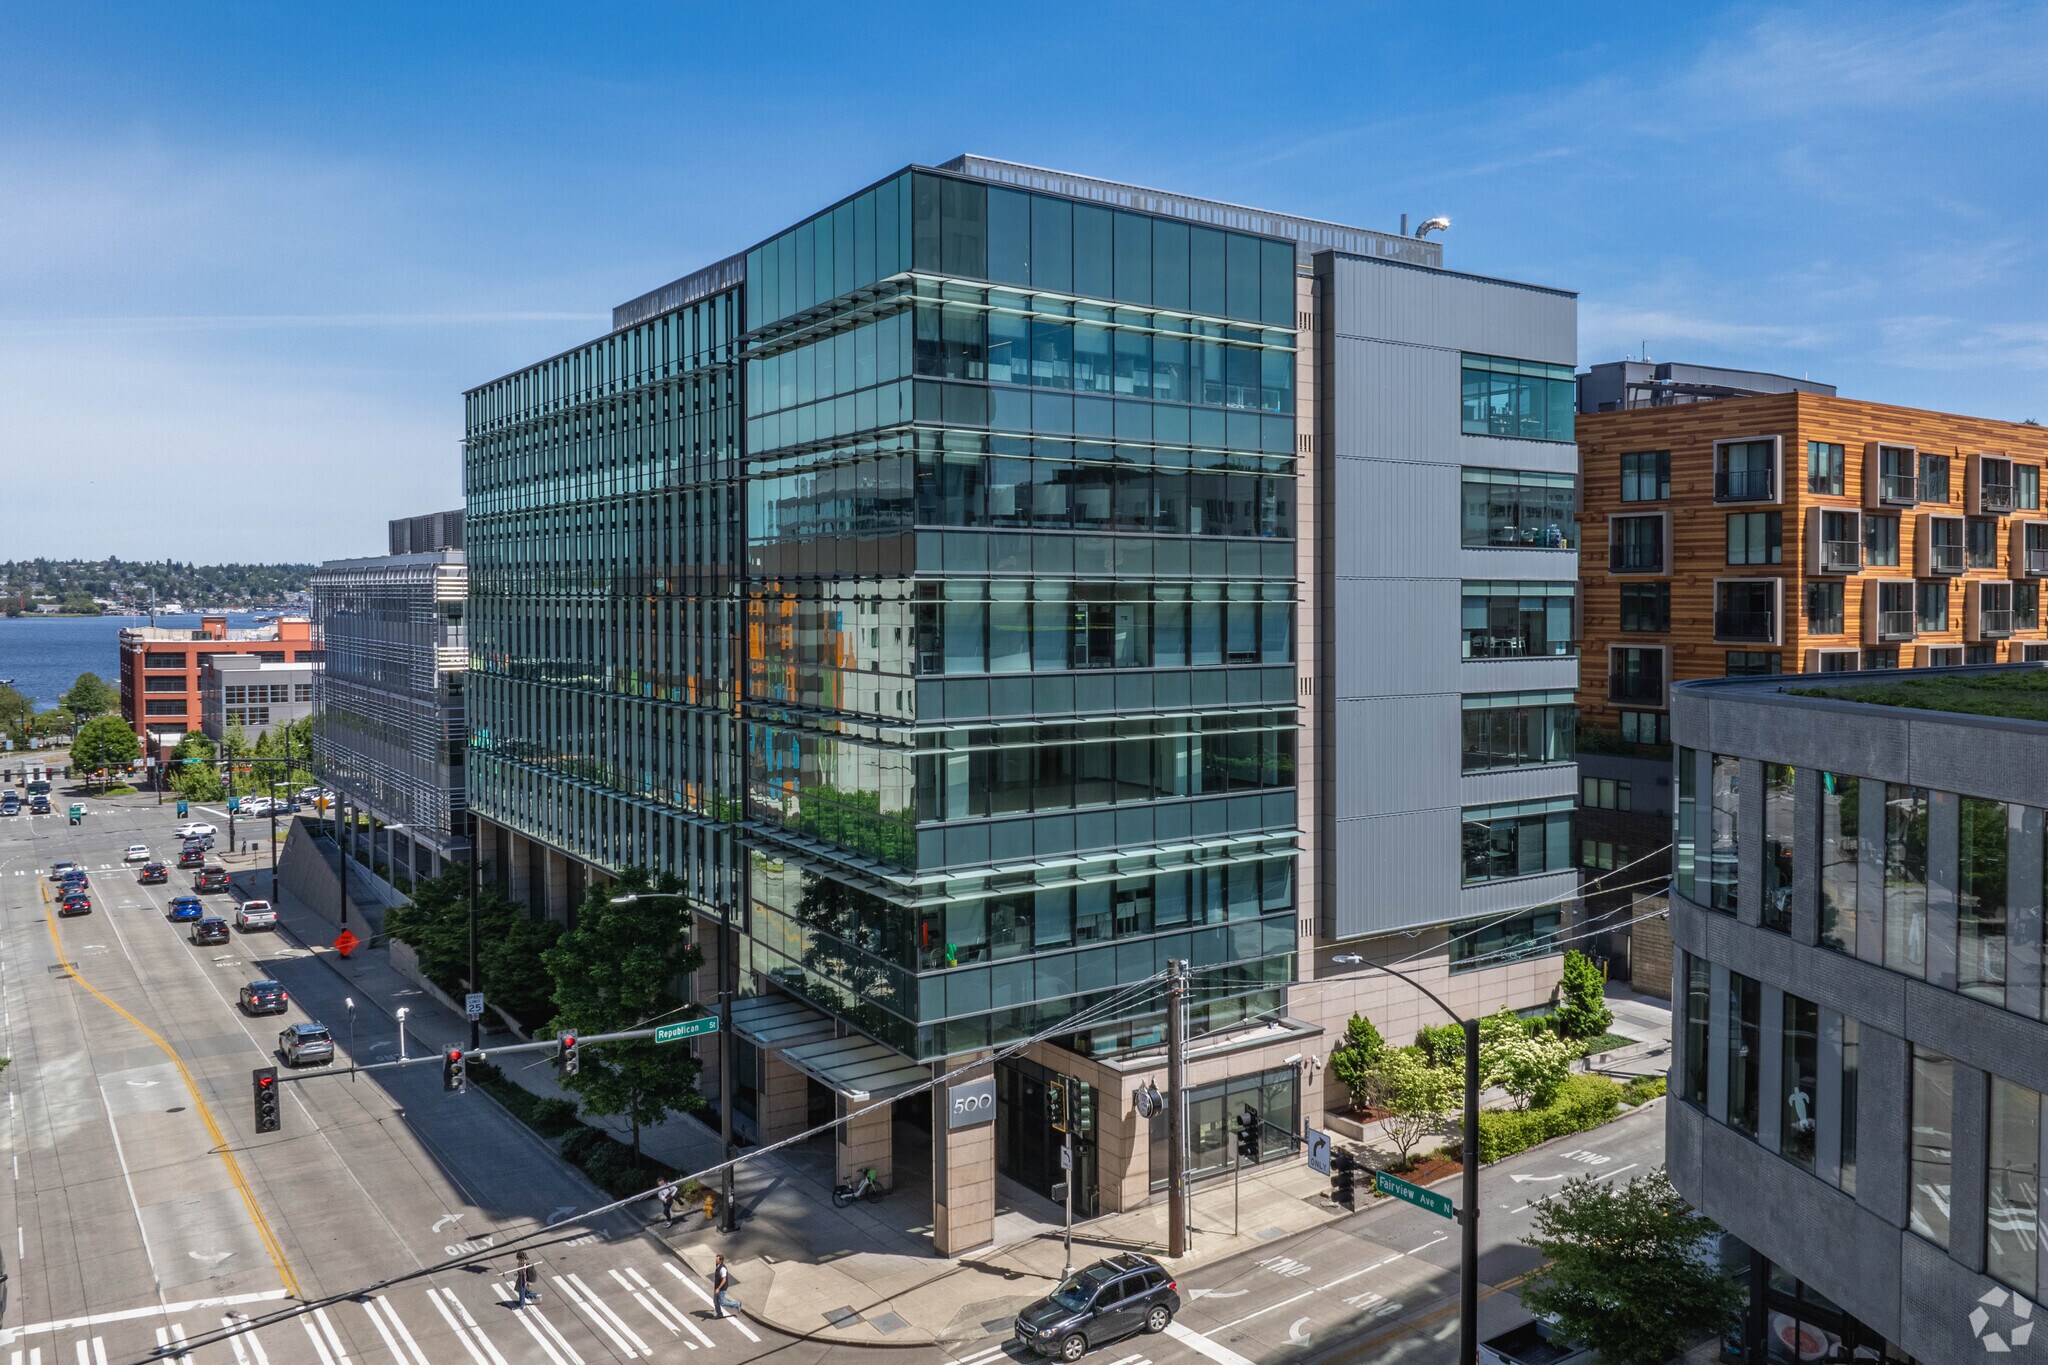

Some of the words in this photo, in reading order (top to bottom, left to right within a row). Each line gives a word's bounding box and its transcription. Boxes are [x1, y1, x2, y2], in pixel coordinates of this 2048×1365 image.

[469, 1004, 482, 1012] 25
[658, 1024, 699, 1039] Republican
[709, 1021, 716, 1029] St
[954, 1093, 992, 1114] 500
[1310, 1158, 1328, 1171] ONLY
[1559, 1149, 1611, 1165] ONLY
[1379, 1176, 1415, 1199] Fairview
[1420, 1194, 1435, 1208] Ave
[1444, 1202, 1450, 1214] N
[444, 1237, 495, 1257] ONLY
[1254, 1255, 1311, 1278] ONLY
[1342, 1291, 1403, 1317] ONLY
